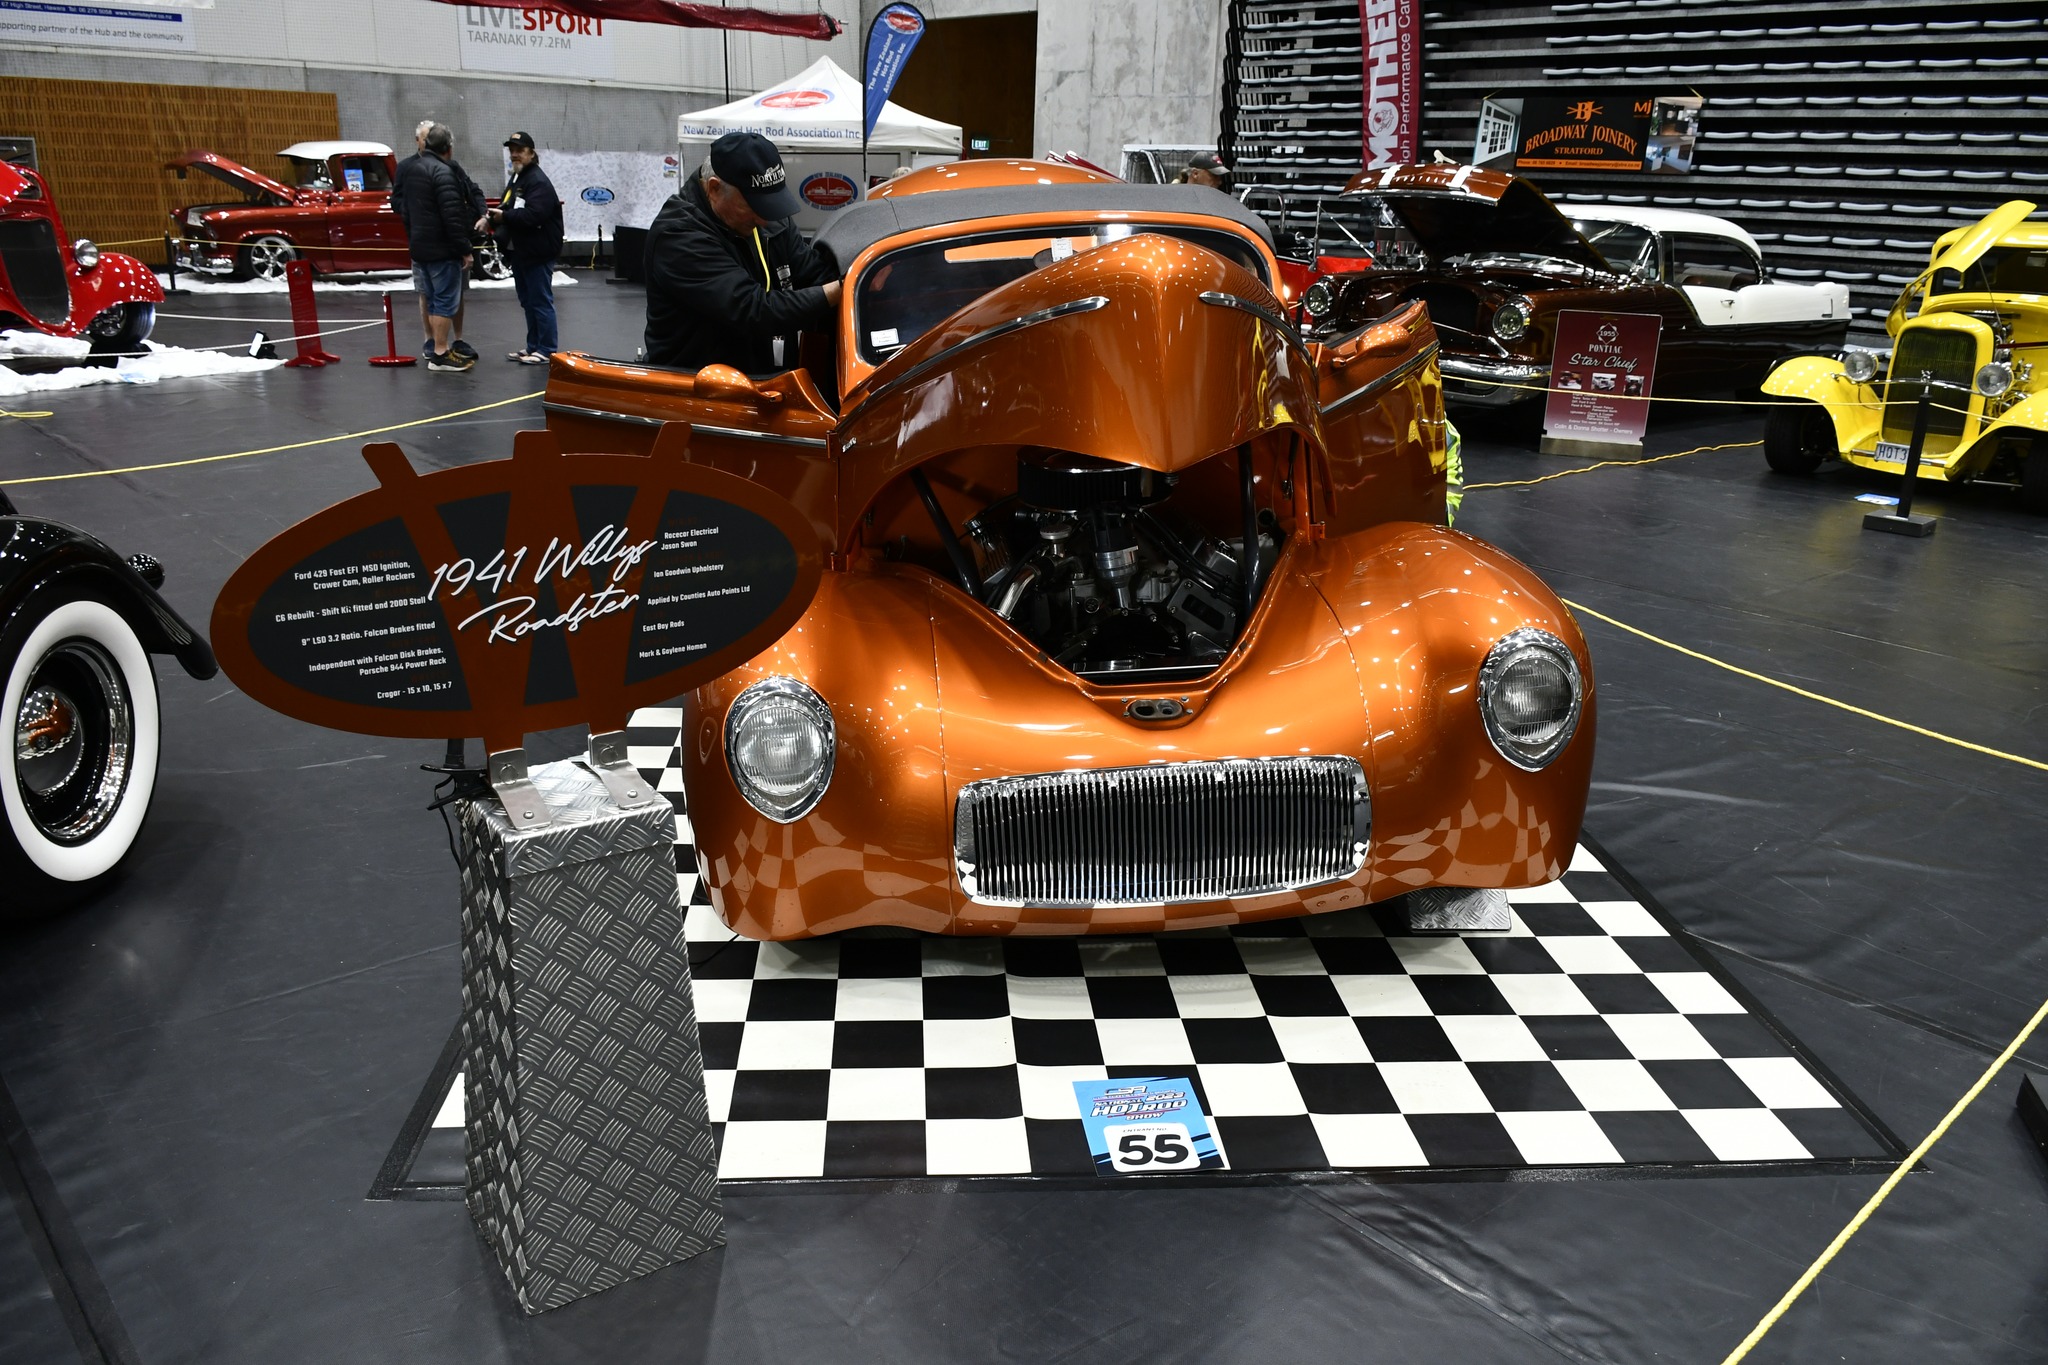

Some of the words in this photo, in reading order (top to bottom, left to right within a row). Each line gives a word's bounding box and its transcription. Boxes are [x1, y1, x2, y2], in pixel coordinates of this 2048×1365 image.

[0, 22, 36, 33] pporting
[38, 25, 66, 34] partner
[80, 27, 93, 35] the
[95, 28, 110, 36] Hub
[113, 30, 127, 38] and
[143, 32, 184, 42] community
[467, 30, 526, 46] TARANAKI
[530, 35, 571, 49] 97.2FM
[868, 77, 876, 90] The
[872, 61, 882, 78] New
[878, 33, 894, 60] Zealand
[880, 64, 890, 77] Hot
[885, 50, 894, 67] Rod
[883, 55, 902, 94] Association
[898, 43, 906, 54] Inc
[1400, 33, 1410, 134] Performance
[684, 125, 704, 136] New
[706, 125, 743, 136] Zealand
[766, 127, 784, 137] Rod
[786, 127, 843, 138] Association
[845, 128, 860, 139] Inc
[1524, 124, 1588, 154] BROADWAY
[1592, 125, 1638, 156] JOINERY
[1400, 140, 1410, 164] igh
[1554, 146, 1604, 156] STRATFORD
[1588, 344, 1622, 354] PONTIAC
[1568, 352, 1602, 366] Star
[1604, 356, 1638, 373] Chief
[1880, 445, 1908, 460] HOT3
[664, 532, 689, 540] Racecar
[690, 526, 718, 536] Electrical
[661, 542, 680, 550] Jason
[294, 572, 312, 580] Ford
[314, 570, 328, 578] 429
[330, 568, 346, 576] Fast
[348, 566, 358, 574] EFI
[362, 564, 378, 572] MSD
[380, 561, 410, 572] Ignition,
[428, 546, 527, 600] 1941
[534, 524, 658, 584] Willys
[665, 567, 691, 577] Goodwin
[692, 564, 724, 573] Upholstery
[314, 580, 340, 590] Crower
[342, 578, 361, 588] Cam,
[362, 576, 384, 585] Roller
[386, 572, 416, 582] Rockers
[648, 596, 670, 606] Applied
[680, 592, 706, 600] Counties
[722, 587, 740, 595] Paints
[276, 614, 286, 622] C6
[288, 610, 315, 621] Rebuilt
[322, 606, 340, 616] Shift
[353, 602, 373, 612] fitted
[374, 601, 388, 610] and
[390, 598, 408, 608] 2000
[410, 596, 426, 606] Stall
[458, 583, 640, 644] Roadster
[312, 636, 326, 645] LSD
[328, 634, 340, 643] 3.2
[341, 632, 362, 641] Ratio.
[364, 628, 388, 638] Falcon
[390, 624, 414, 634] Brakes
[416, 621, 436, 630] fitted
[643, 624, 656, 632] East
[658, 622, 668, 630] Bay
[670, 620, 685, 628] Rods
[309, 660, 355, 672] Independent
[356, 656, 373, 666] with
[374, 653, 398, 662] Falcon
[400, 650, 416, 658] Disk
[417, 646, 444, 656] Brakes.
[640, 650, 654, 658] Mark
[662, 646, 685, 656] Gaylene
[360, 665, 388, 676] Porsche
[390, 662, 404, 672] 944
[405, 660, 428, 670] Power
[429, 657, 446, 666] Rack
[377, 690, 400, 699] Cragar
[408, 686, 416, 694] 15
[422, 684, 432, 693] 10,
[434, 682, 441, 691] 15
[1145, 1092, 1186, 1102] 2023
[1118, 1134, 1189, 1166] 55
